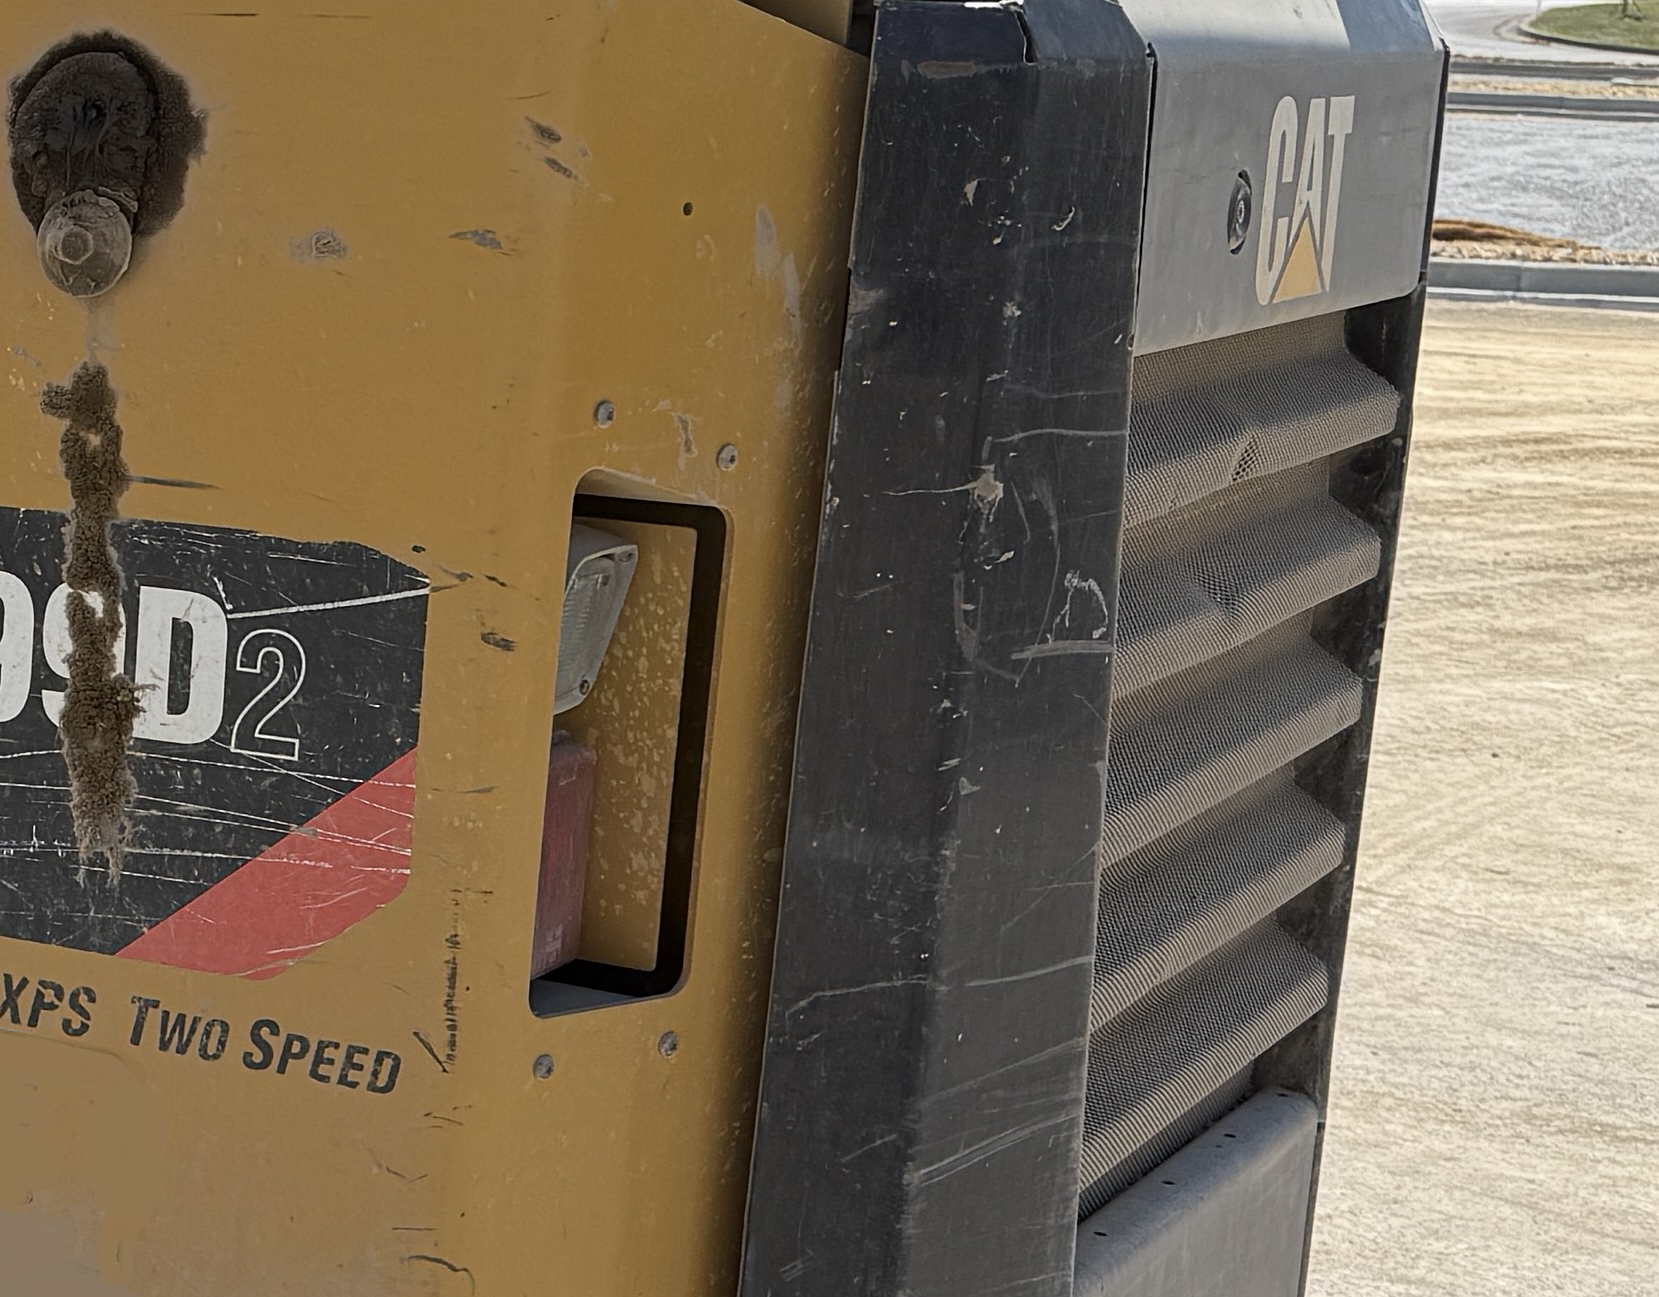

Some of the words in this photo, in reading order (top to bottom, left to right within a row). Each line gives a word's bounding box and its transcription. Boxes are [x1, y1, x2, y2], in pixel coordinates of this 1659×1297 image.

[1255, 95, 1356, 305] CAT
[129, 995, 230, 1062] TWO
[242, 1018, 402, 1095] SPEED
